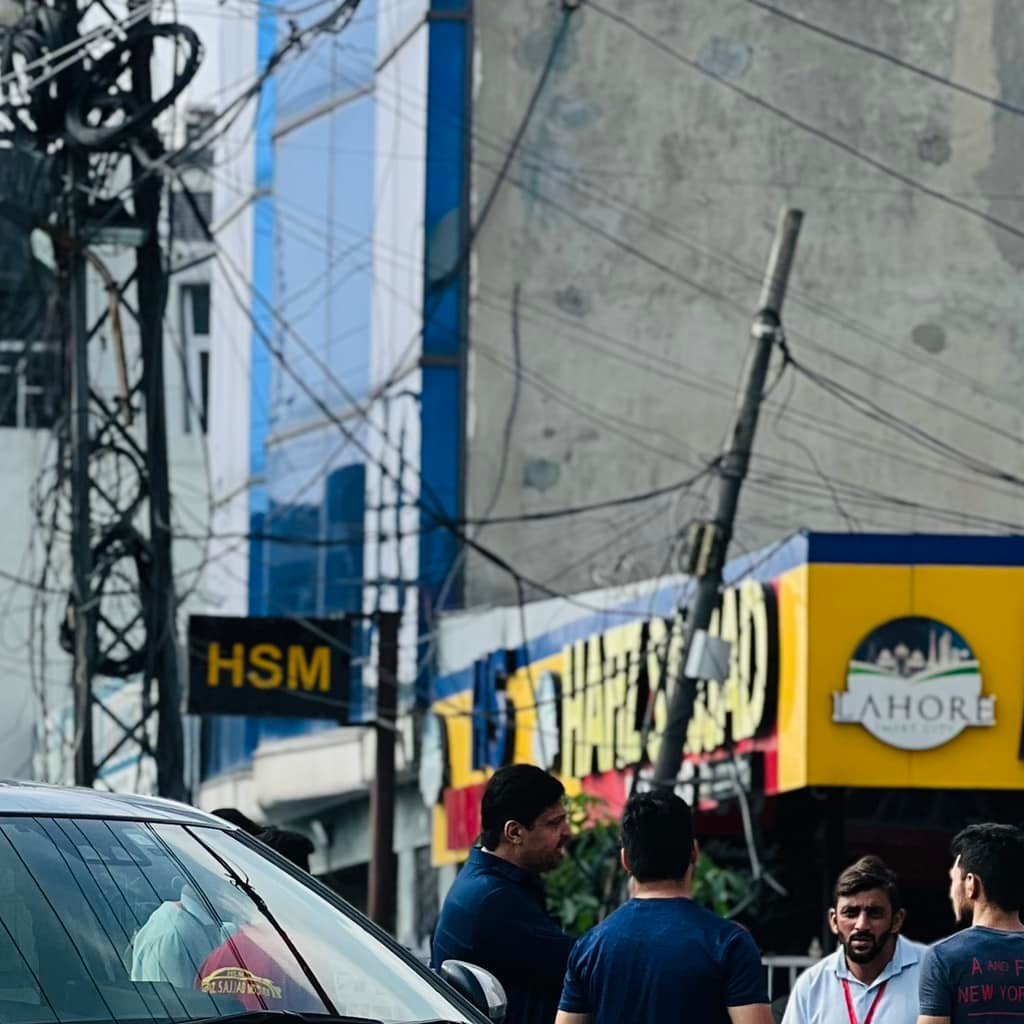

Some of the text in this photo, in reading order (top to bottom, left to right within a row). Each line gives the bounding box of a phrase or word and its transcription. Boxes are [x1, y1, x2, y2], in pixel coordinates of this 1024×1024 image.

[207, 642, 331, 691] HSM
[834, 693, 994, 722] LAHORE
[971, 957, 983, 976] A
[958, 984, 993, 1003] NEW
